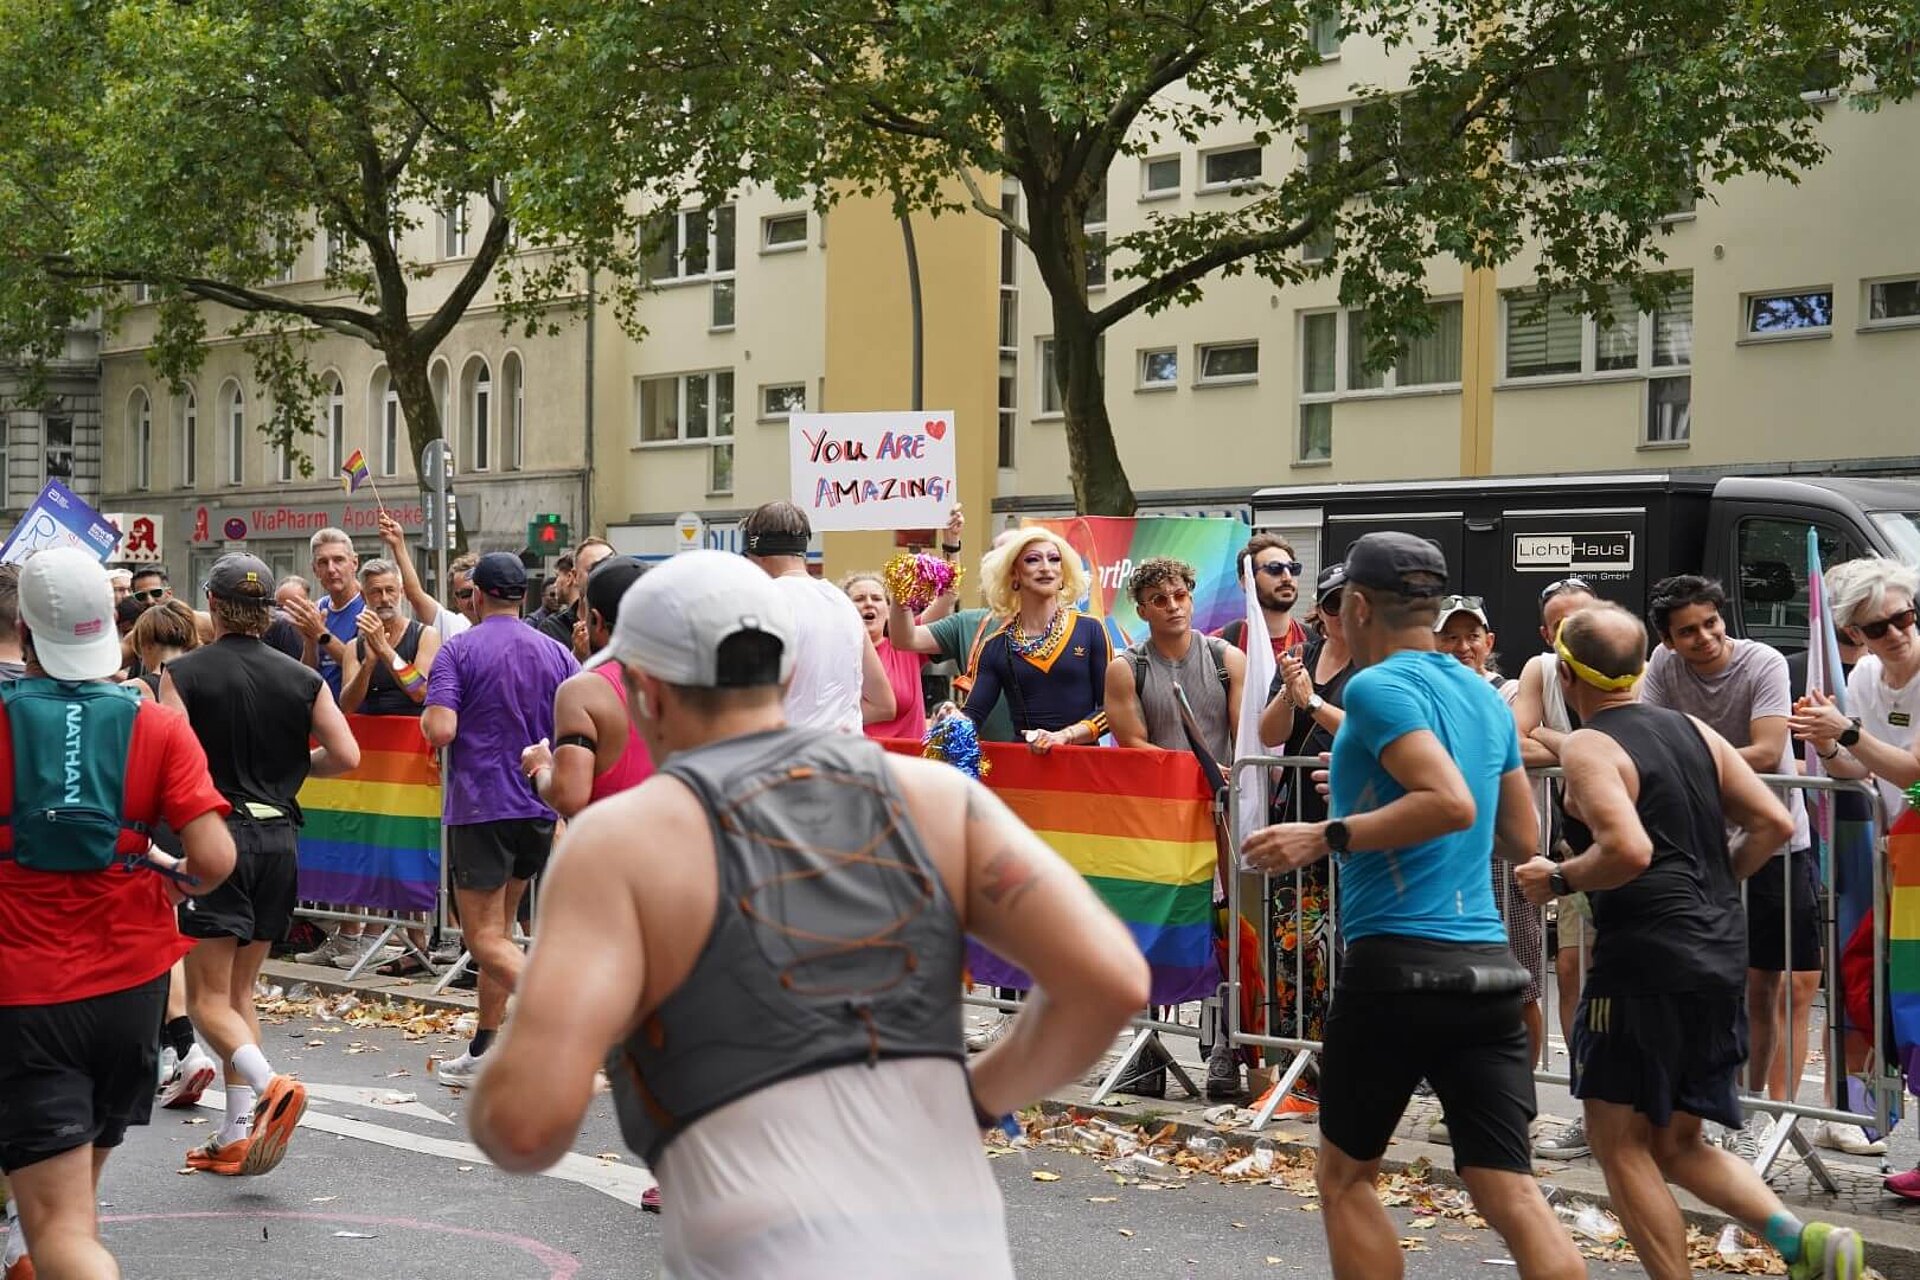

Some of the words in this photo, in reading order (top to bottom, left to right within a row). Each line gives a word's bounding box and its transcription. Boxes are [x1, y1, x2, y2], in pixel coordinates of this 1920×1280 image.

[876, 431, 925, 460] ARE
[815, 477, 951, 508] AMAZING!
[252, 508, 328, 531] ViaPharm
[1601, 572, 1630, 581] GmbH
[64, 703, 82, 805] NATHAN
